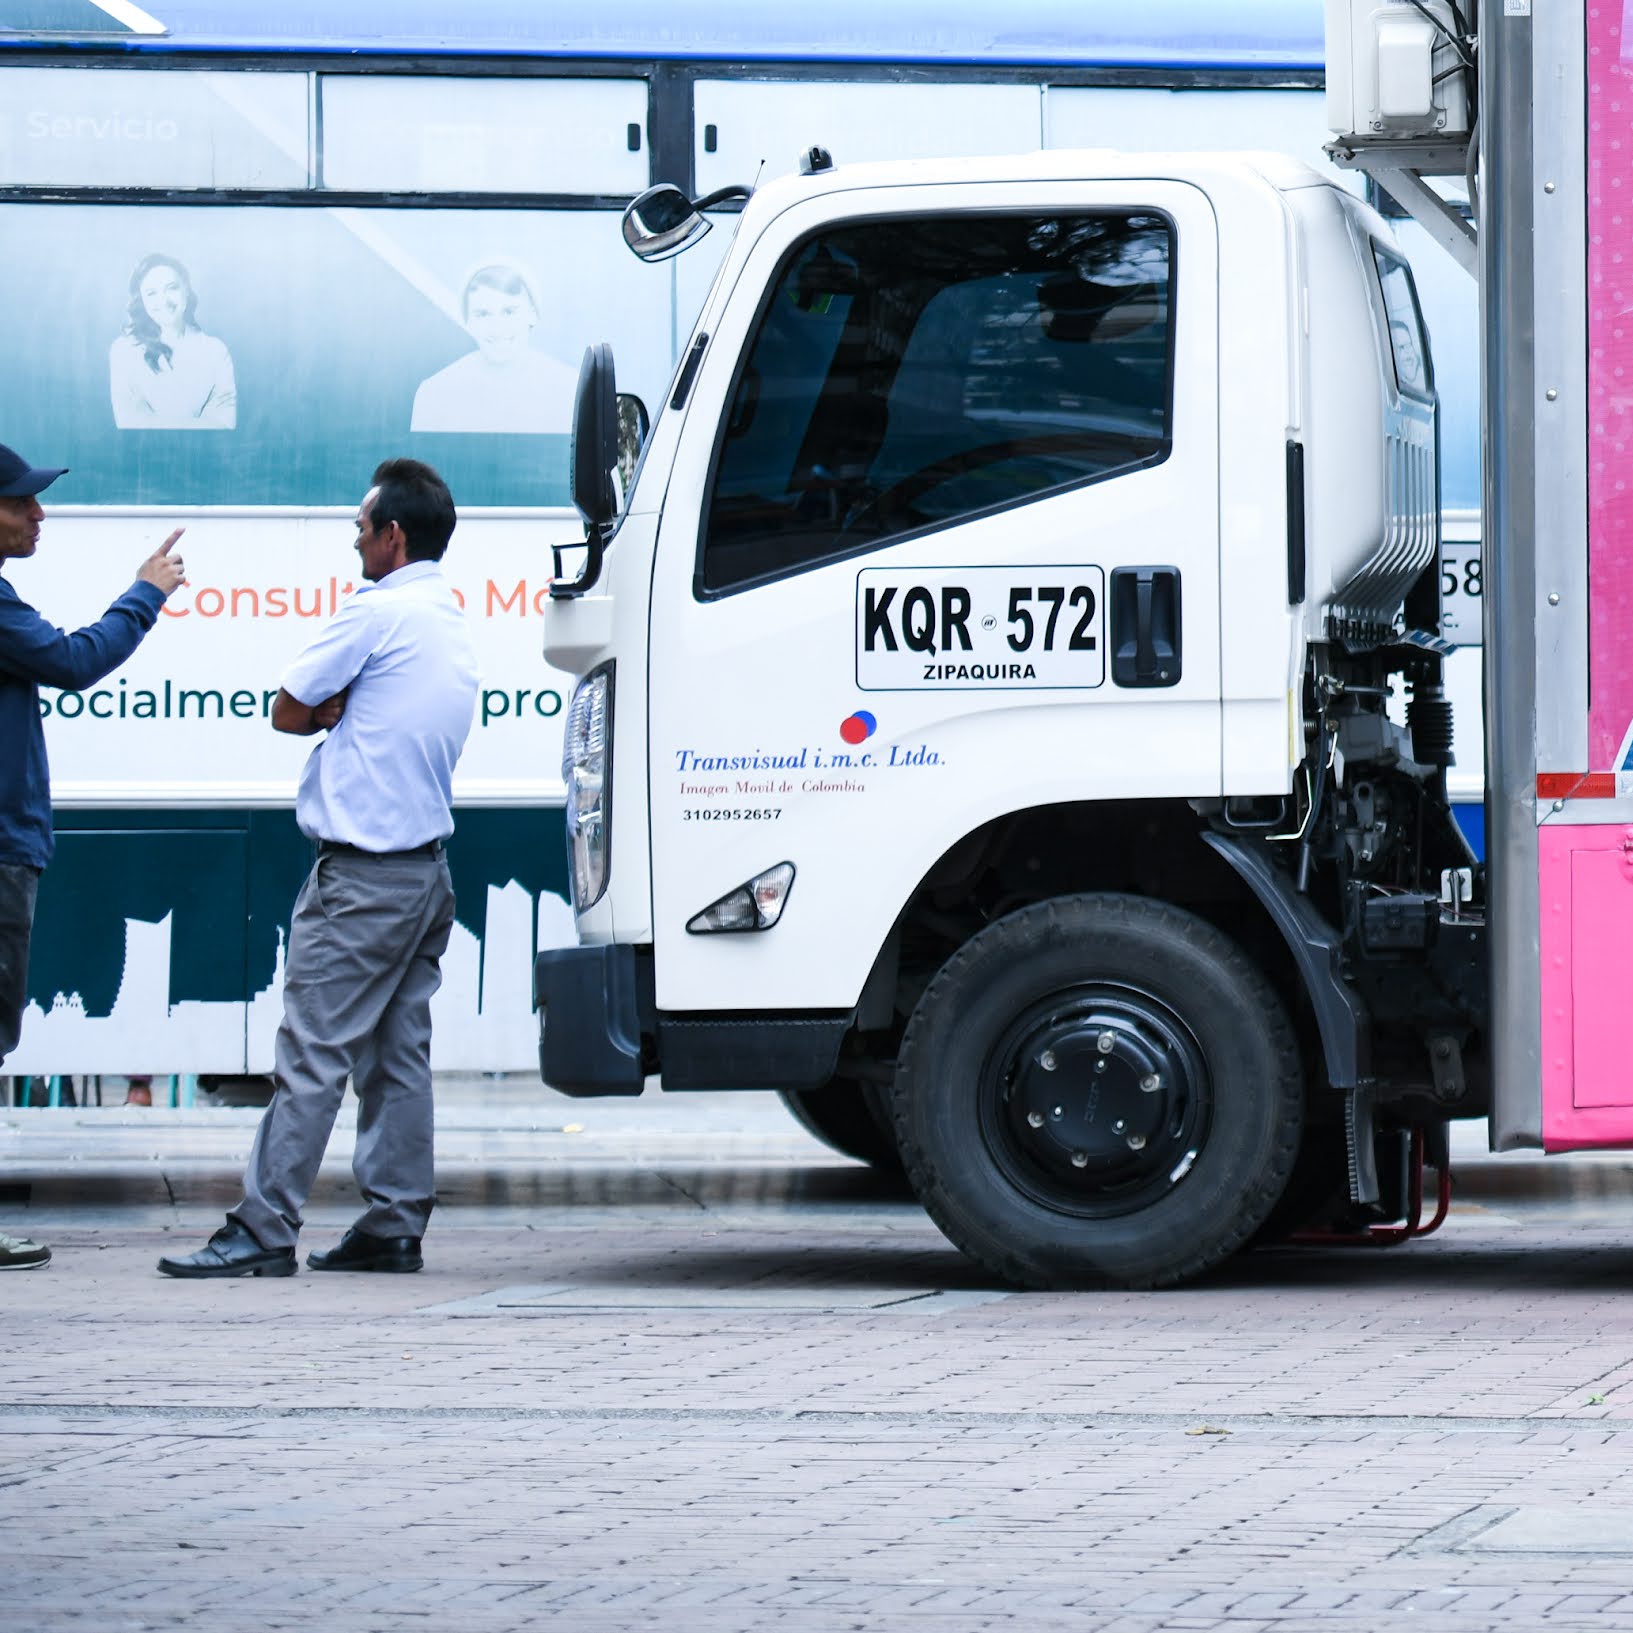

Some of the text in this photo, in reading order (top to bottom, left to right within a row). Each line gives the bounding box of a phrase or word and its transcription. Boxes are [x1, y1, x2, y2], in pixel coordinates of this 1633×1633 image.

[26, 110, 179, 142] Servicio
[1442, 558, 1483, 597] 58
[864, 586, 1096, 657] KQR 572
[923, 664, 1036, 681] ZIPAQUIRA
[482, 689, 571, 727] pro
[676, 745, 946, 772] Transvisual i.m.c. Ltda.
[679, 779, 865, 797] Imagen Movil de Colombia
[682, 808, 782, 821] 3102952657
